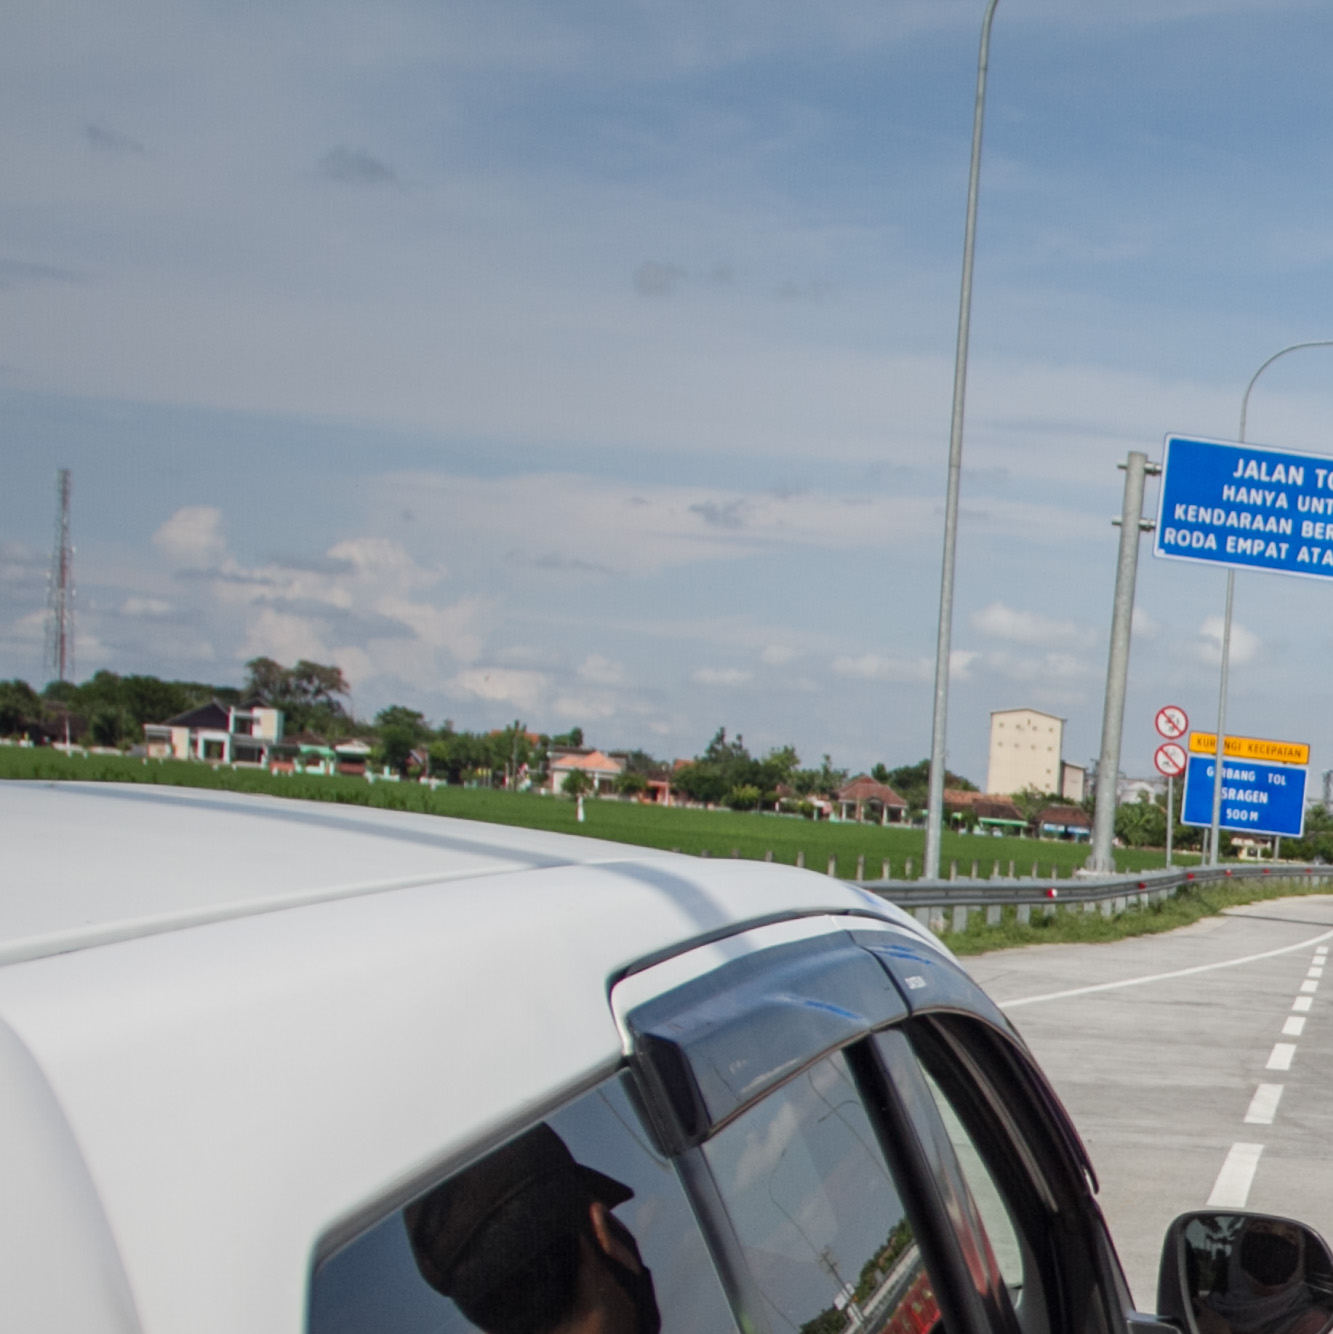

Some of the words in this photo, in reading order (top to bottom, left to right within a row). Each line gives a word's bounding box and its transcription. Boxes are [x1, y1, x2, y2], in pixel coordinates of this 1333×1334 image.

[1233, 458, 1304, 486] JALAN
[1222, 484, 1288, 510] HANYA
[1173, 503, 1293, 535] KENDARAAN
[1163, 527, 1217, 550] RODA
[1225, 536, 1289, 560] EMPAT
[1197, 737, 1241, 751] KURNGI
[1247, 743, 1302, 758] KECEPATAN
[1206, 766, 1256, 782] GRBANG
[1268, 773, 1287, 786] TOL
[1221, 787, 1269, 804] SRAGEN
[1226, 808, 1248, 821] 500
